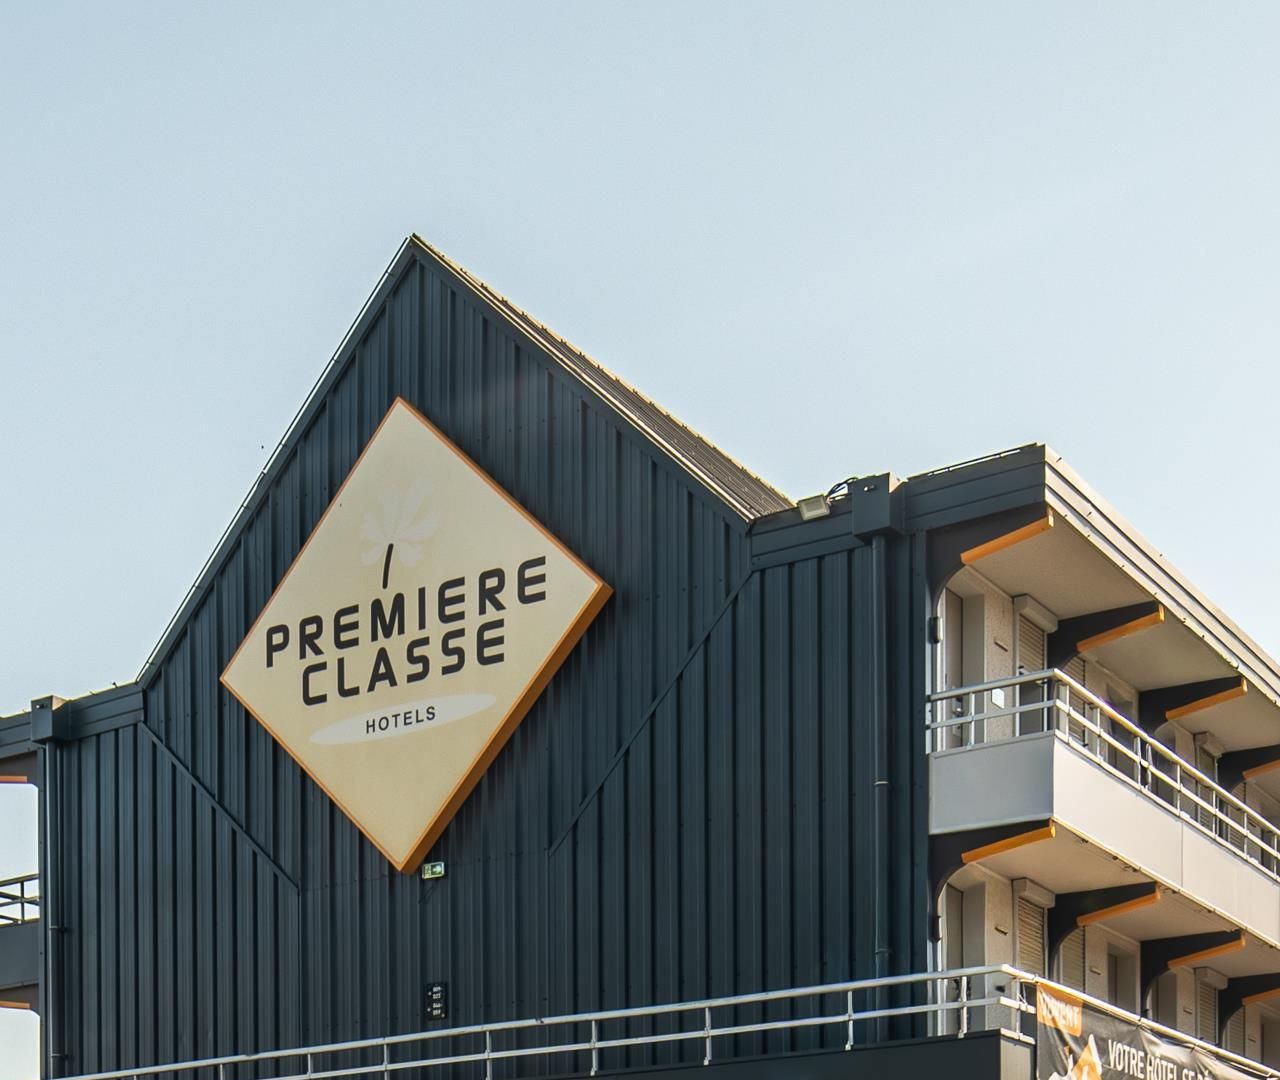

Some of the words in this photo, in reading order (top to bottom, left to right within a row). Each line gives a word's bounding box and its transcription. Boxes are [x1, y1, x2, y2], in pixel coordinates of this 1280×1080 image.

[302, 618, 505, 706] CLASSE
[365, 706, 436, 734] HOTELS
[1108, 1039, 1145, 1079] VOTRE
